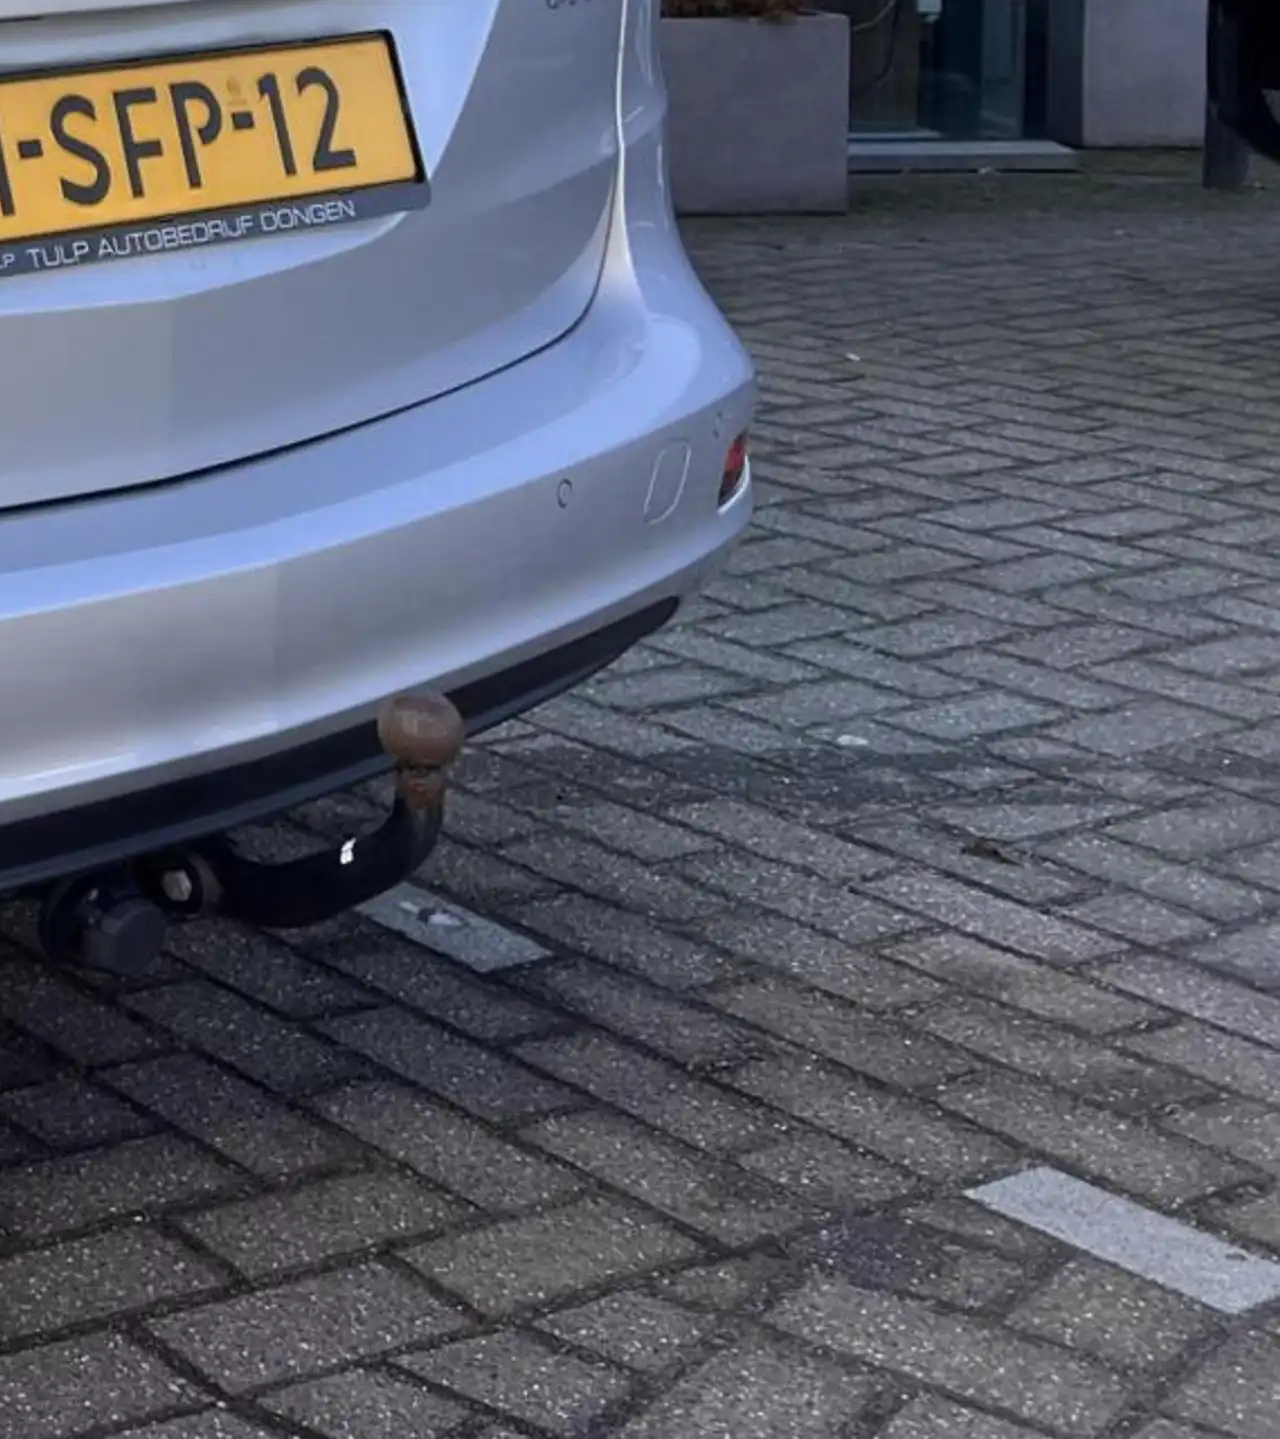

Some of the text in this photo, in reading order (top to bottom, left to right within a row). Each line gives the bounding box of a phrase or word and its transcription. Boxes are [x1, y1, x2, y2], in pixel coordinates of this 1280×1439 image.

[27, 199, 357, 269] TULP AUTOBEDRIJF DONGEN
